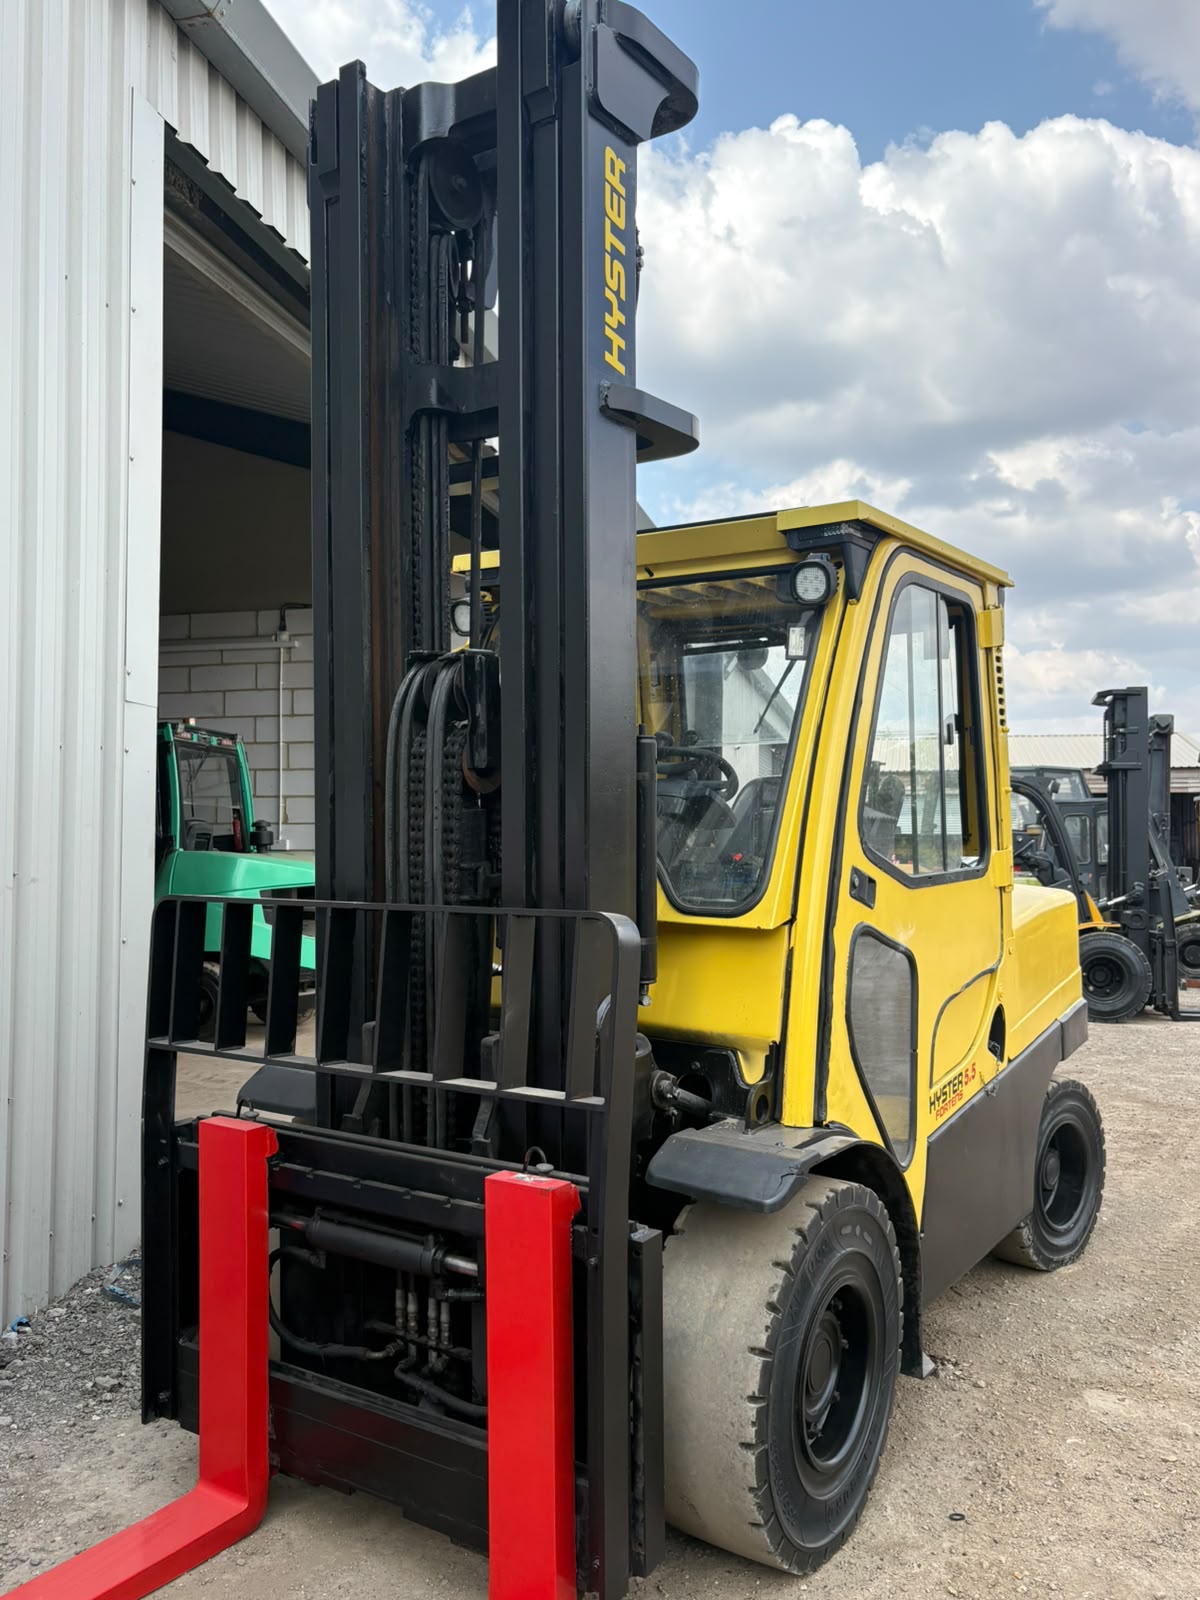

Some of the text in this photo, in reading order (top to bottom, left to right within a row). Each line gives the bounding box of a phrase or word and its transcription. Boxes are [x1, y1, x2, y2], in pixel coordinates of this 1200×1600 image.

[604, 146, 625, 376] HYSTER
[929, 1062, 976, 1114] HYSTER 5.5
